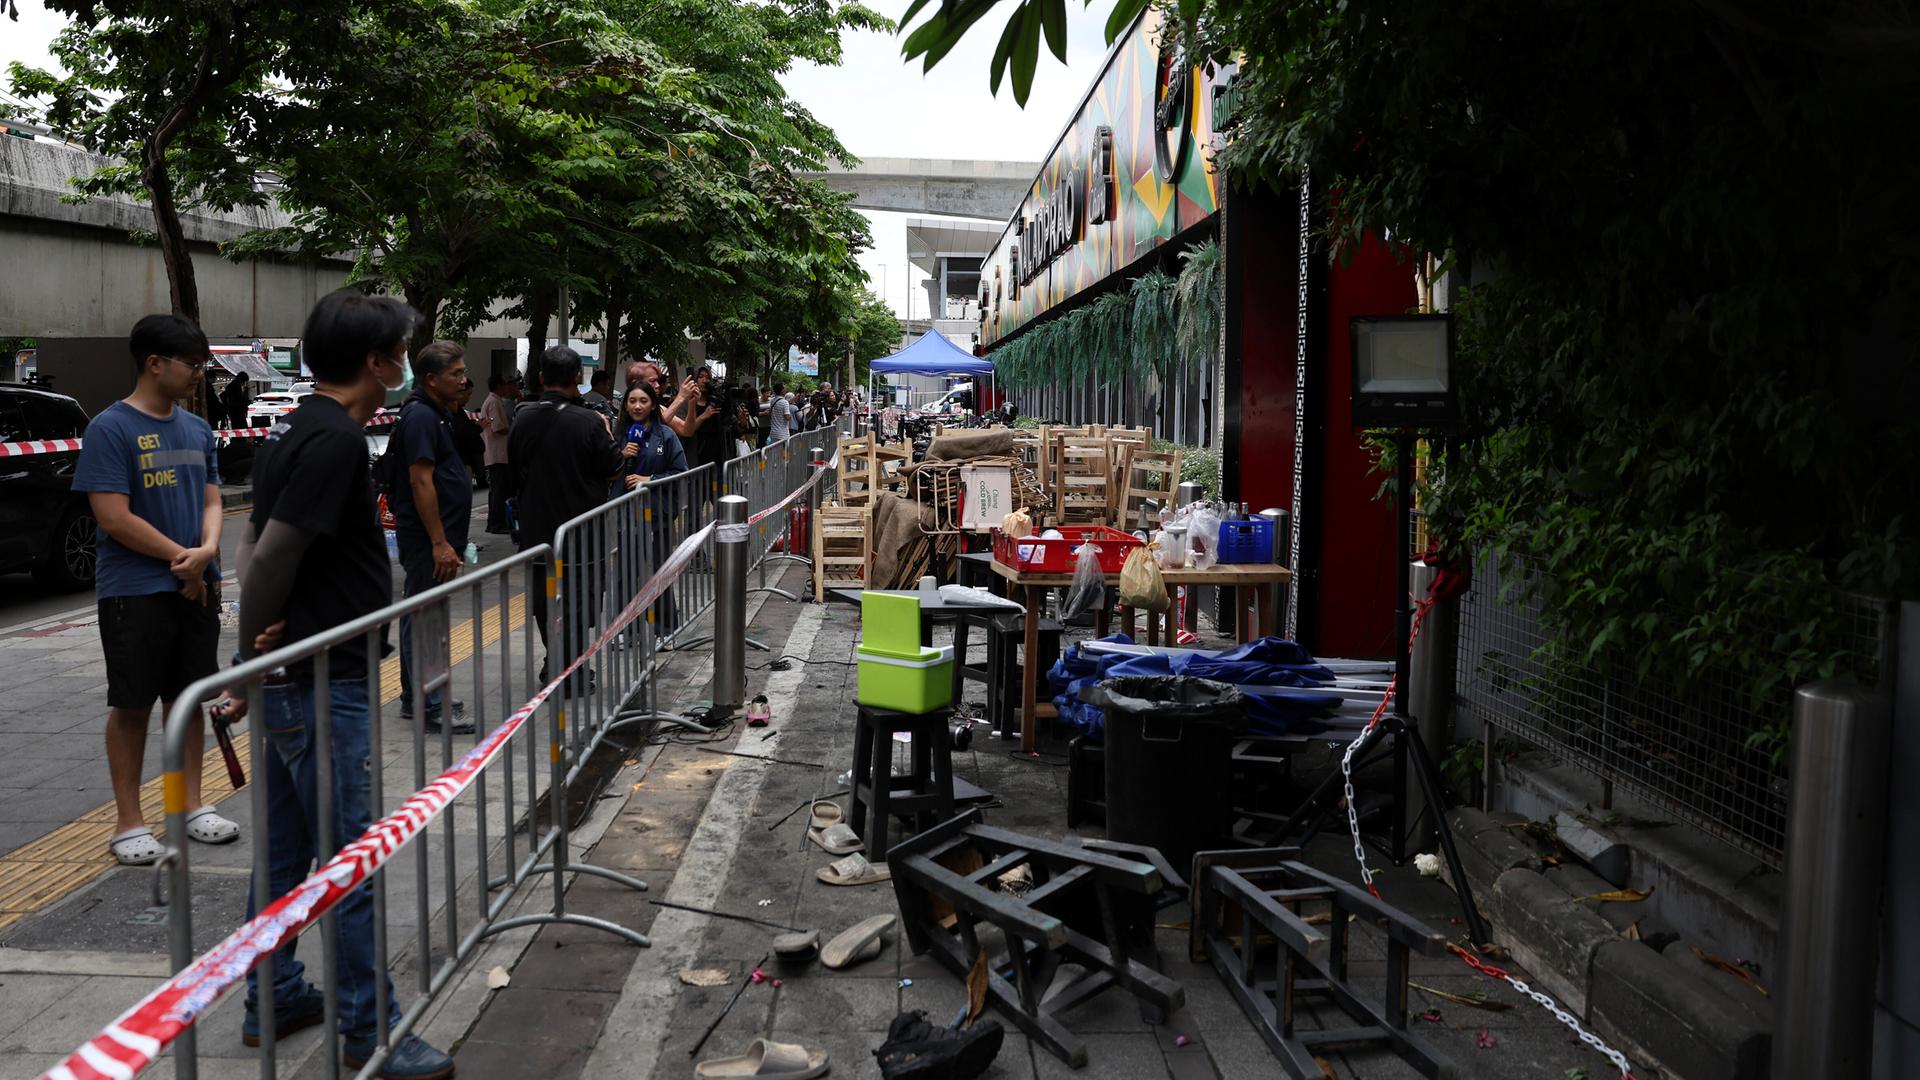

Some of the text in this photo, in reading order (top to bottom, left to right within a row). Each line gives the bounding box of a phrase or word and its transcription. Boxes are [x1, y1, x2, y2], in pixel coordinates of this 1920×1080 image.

[634, 429, 643, 438] N
[137, 434, 161, 450] GET
[140, 453, 154, 470] IT
